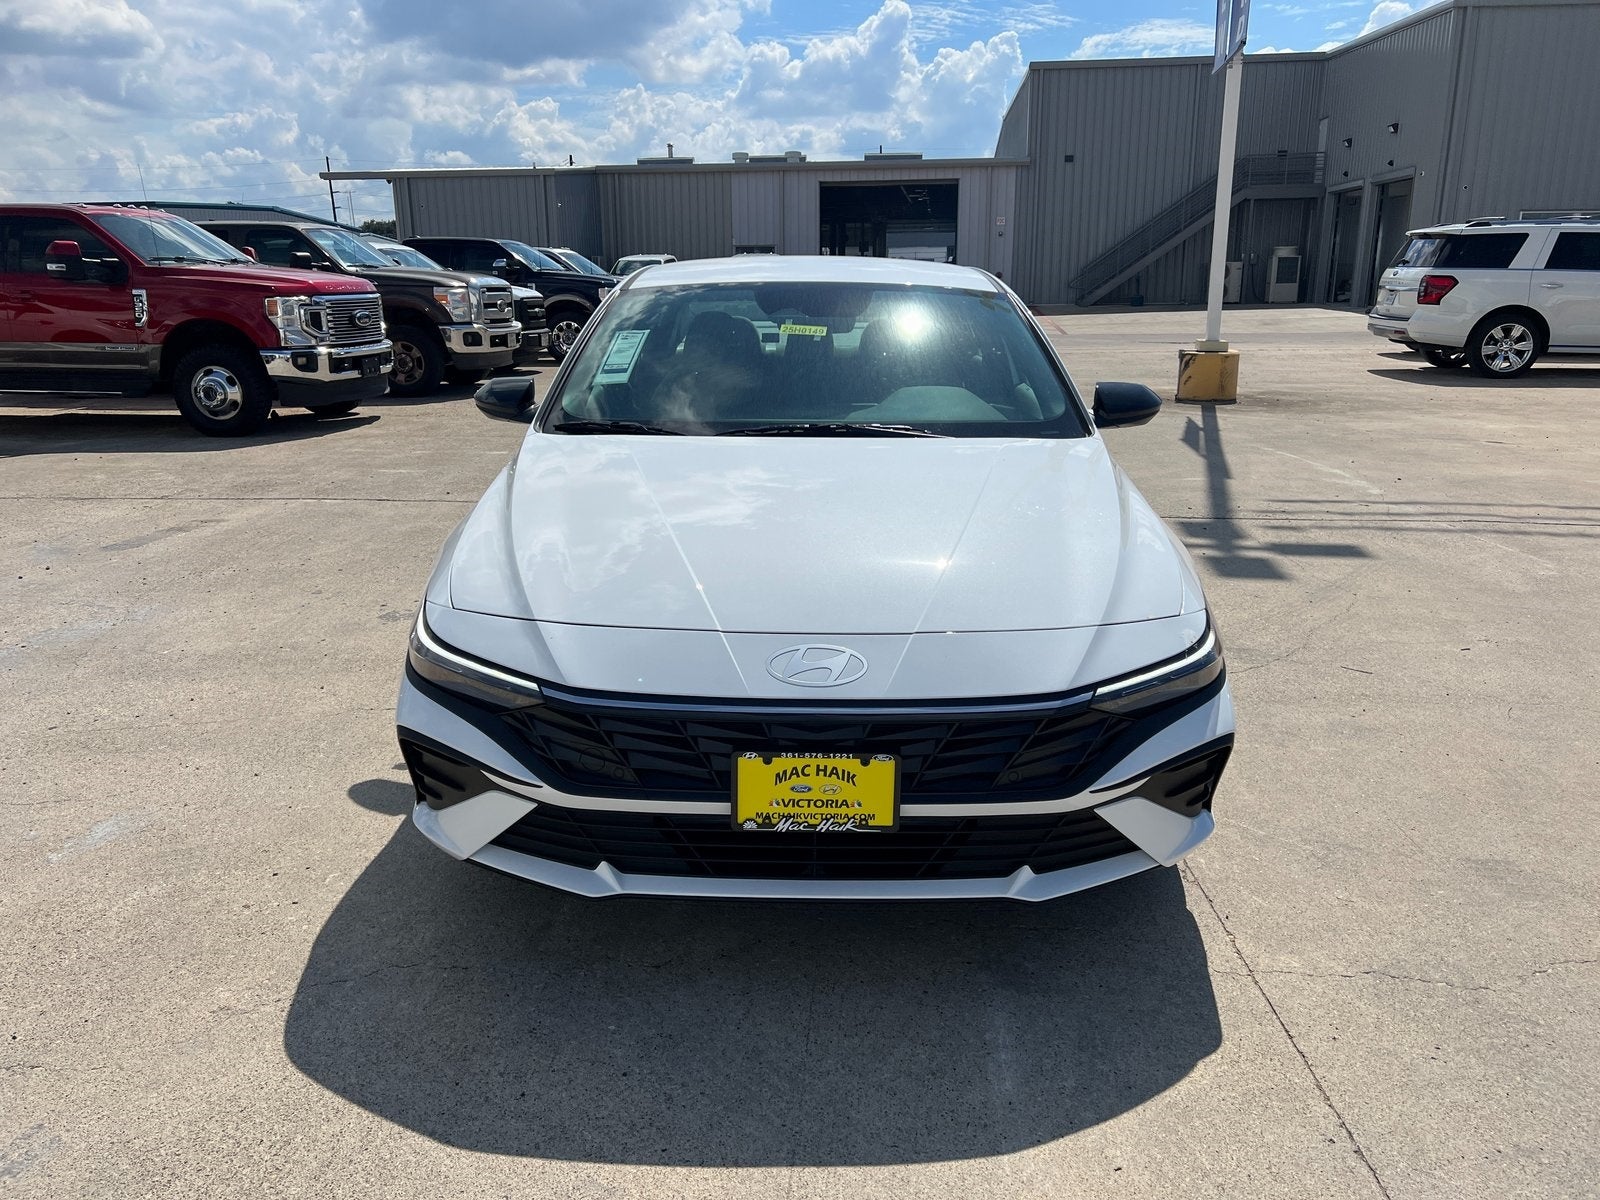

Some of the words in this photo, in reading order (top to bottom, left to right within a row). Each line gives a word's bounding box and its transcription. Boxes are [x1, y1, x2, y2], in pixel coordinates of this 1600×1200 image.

[781, 326, 824, 335] 25H0149
[774, 764, 811, 786] MAC
[815, 764, 857, 787] HAIK
[781, 798, 849, 808] VICTORIA
[755, 812, 876, 820] MACHAIKVICTORIACOM
[774, 817, 812, 832] Mac
[815, 818, 866, 832] Haik
